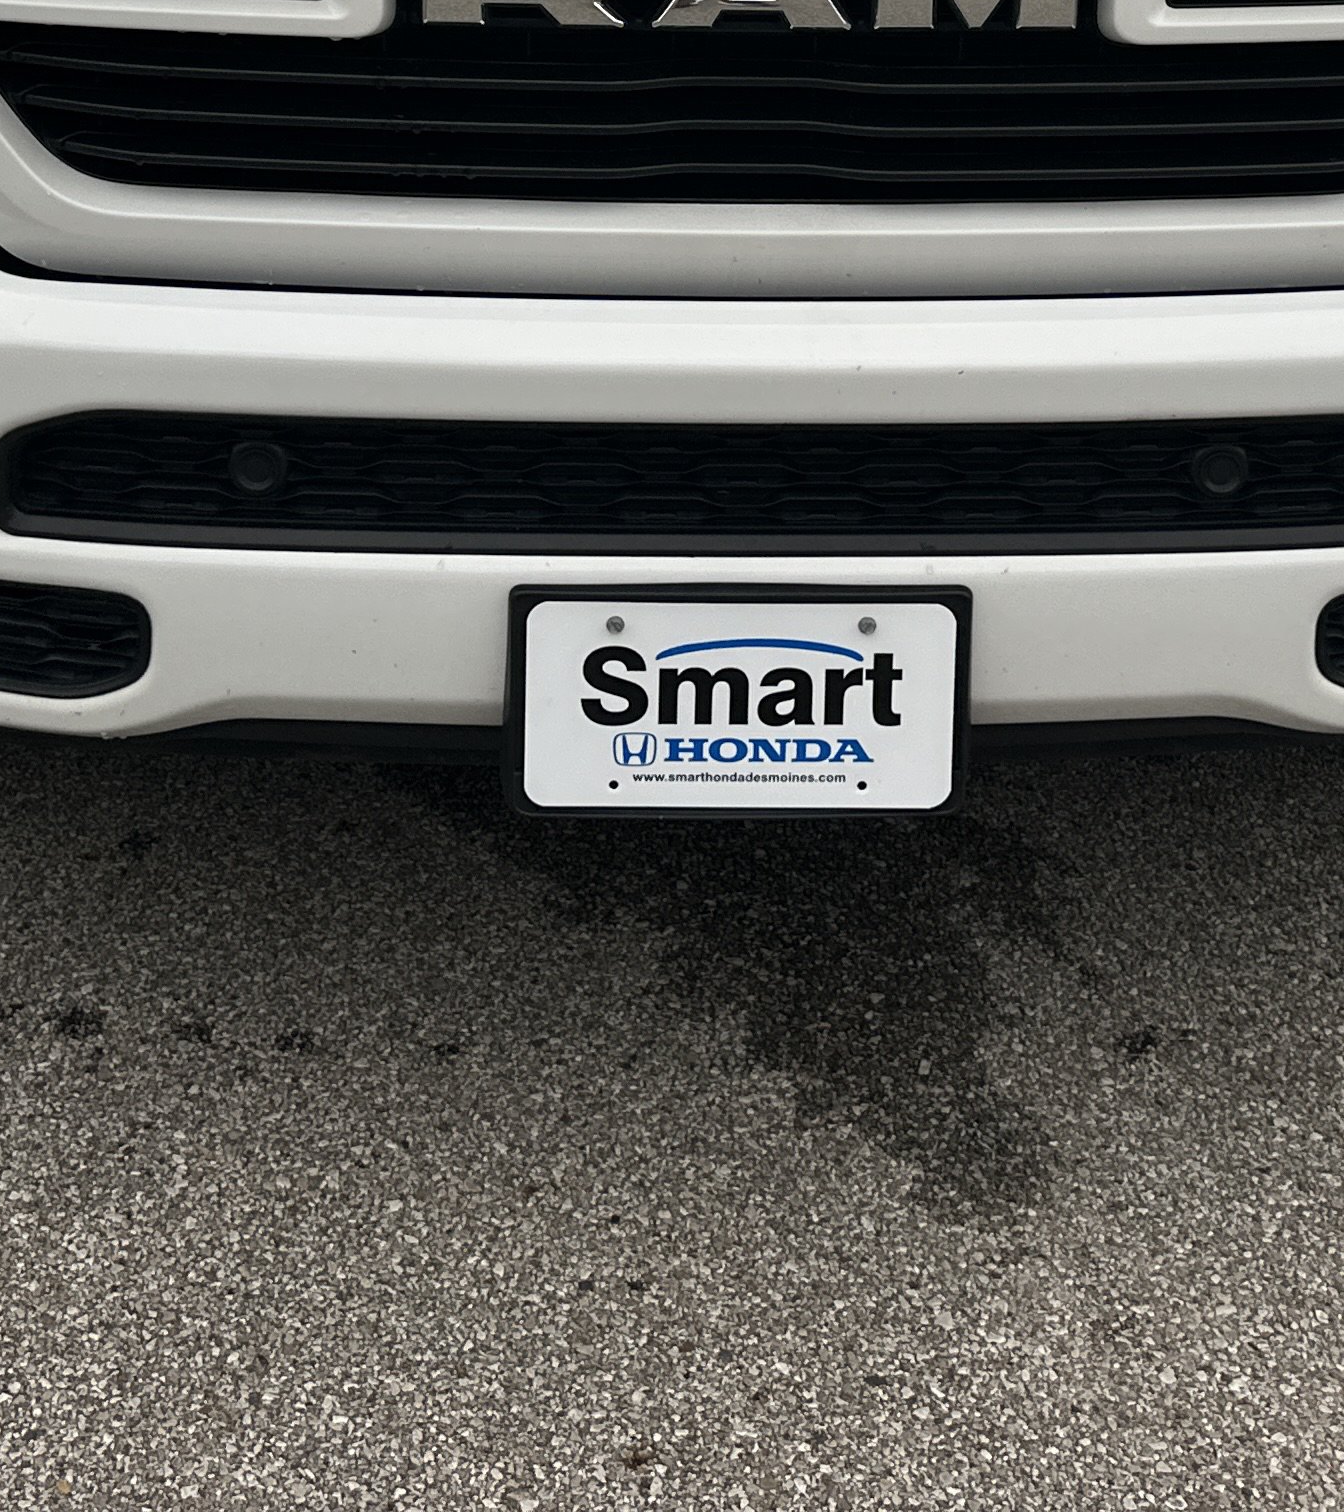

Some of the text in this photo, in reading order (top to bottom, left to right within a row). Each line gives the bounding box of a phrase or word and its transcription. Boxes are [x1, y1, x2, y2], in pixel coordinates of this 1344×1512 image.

[580, 645, 903, 727] Smart
[664, 738, 874, 763] HONDA
[633, 772, 847, 784] www.smarthondadesmoines.com
